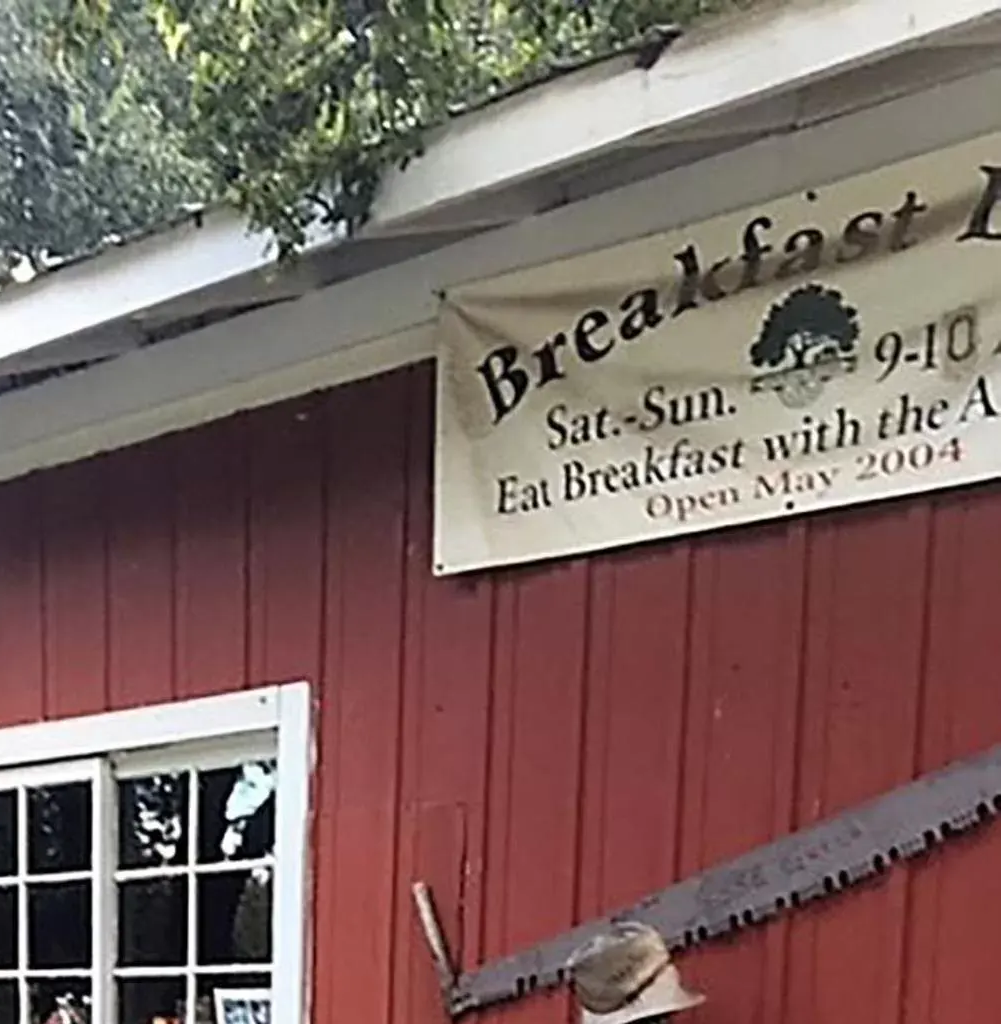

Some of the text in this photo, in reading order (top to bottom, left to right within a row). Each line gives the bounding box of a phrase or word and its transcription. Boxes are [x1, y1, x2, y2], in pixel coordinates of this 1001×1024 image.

[477, 190, 927, 425] Breakfast
[546, 313, 976, 450] Sat.-Sun. 9-10
[496, 475, 552, 515] Eat
[563, 438, 744, 502] Breakfast
[763, 407, 861, 461] with
[877, 394, 949, 439] the
[646, 437, 962, 521] Open May 2004
